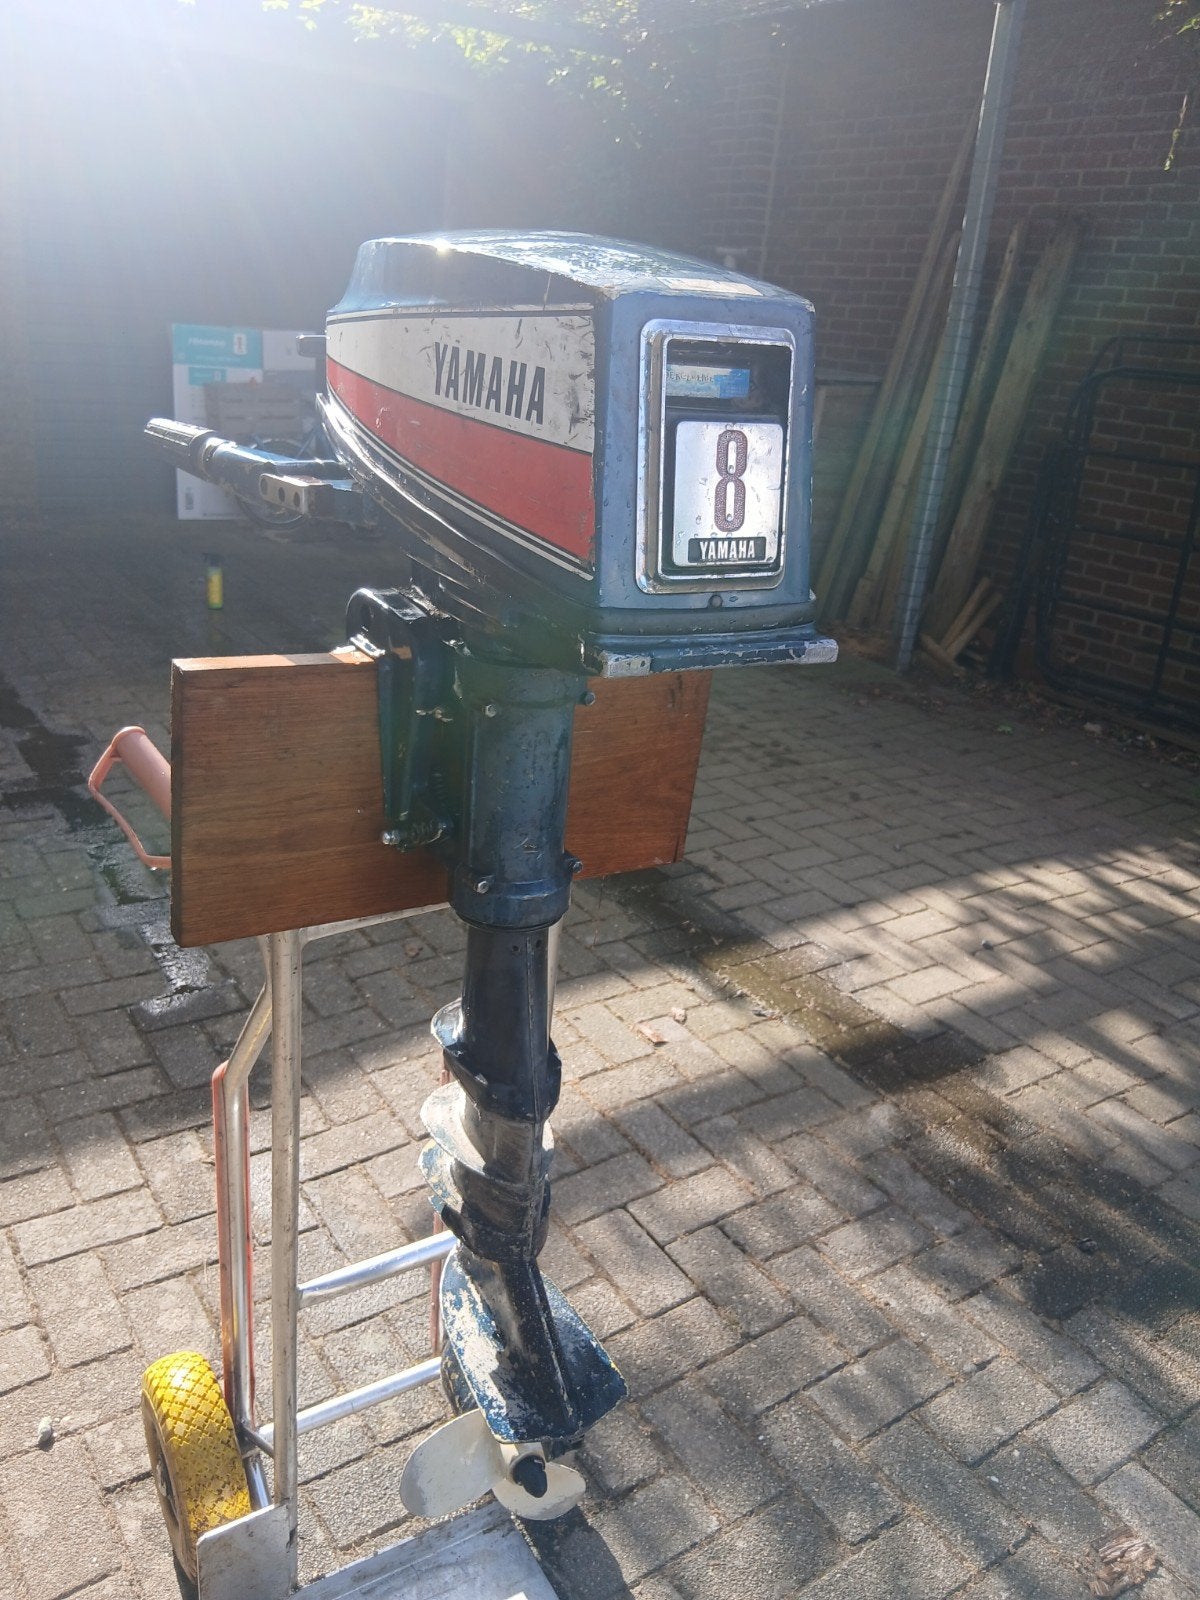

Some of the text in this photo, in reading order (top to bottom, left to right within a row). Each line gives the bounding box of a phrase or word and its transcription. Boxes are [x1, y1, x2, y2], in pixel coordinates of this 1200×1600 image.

[434, 341, 546, 425] YAMAHA
[714, 429, 748, 533] 8
[699, 539, 756, 560] YAMAHA
